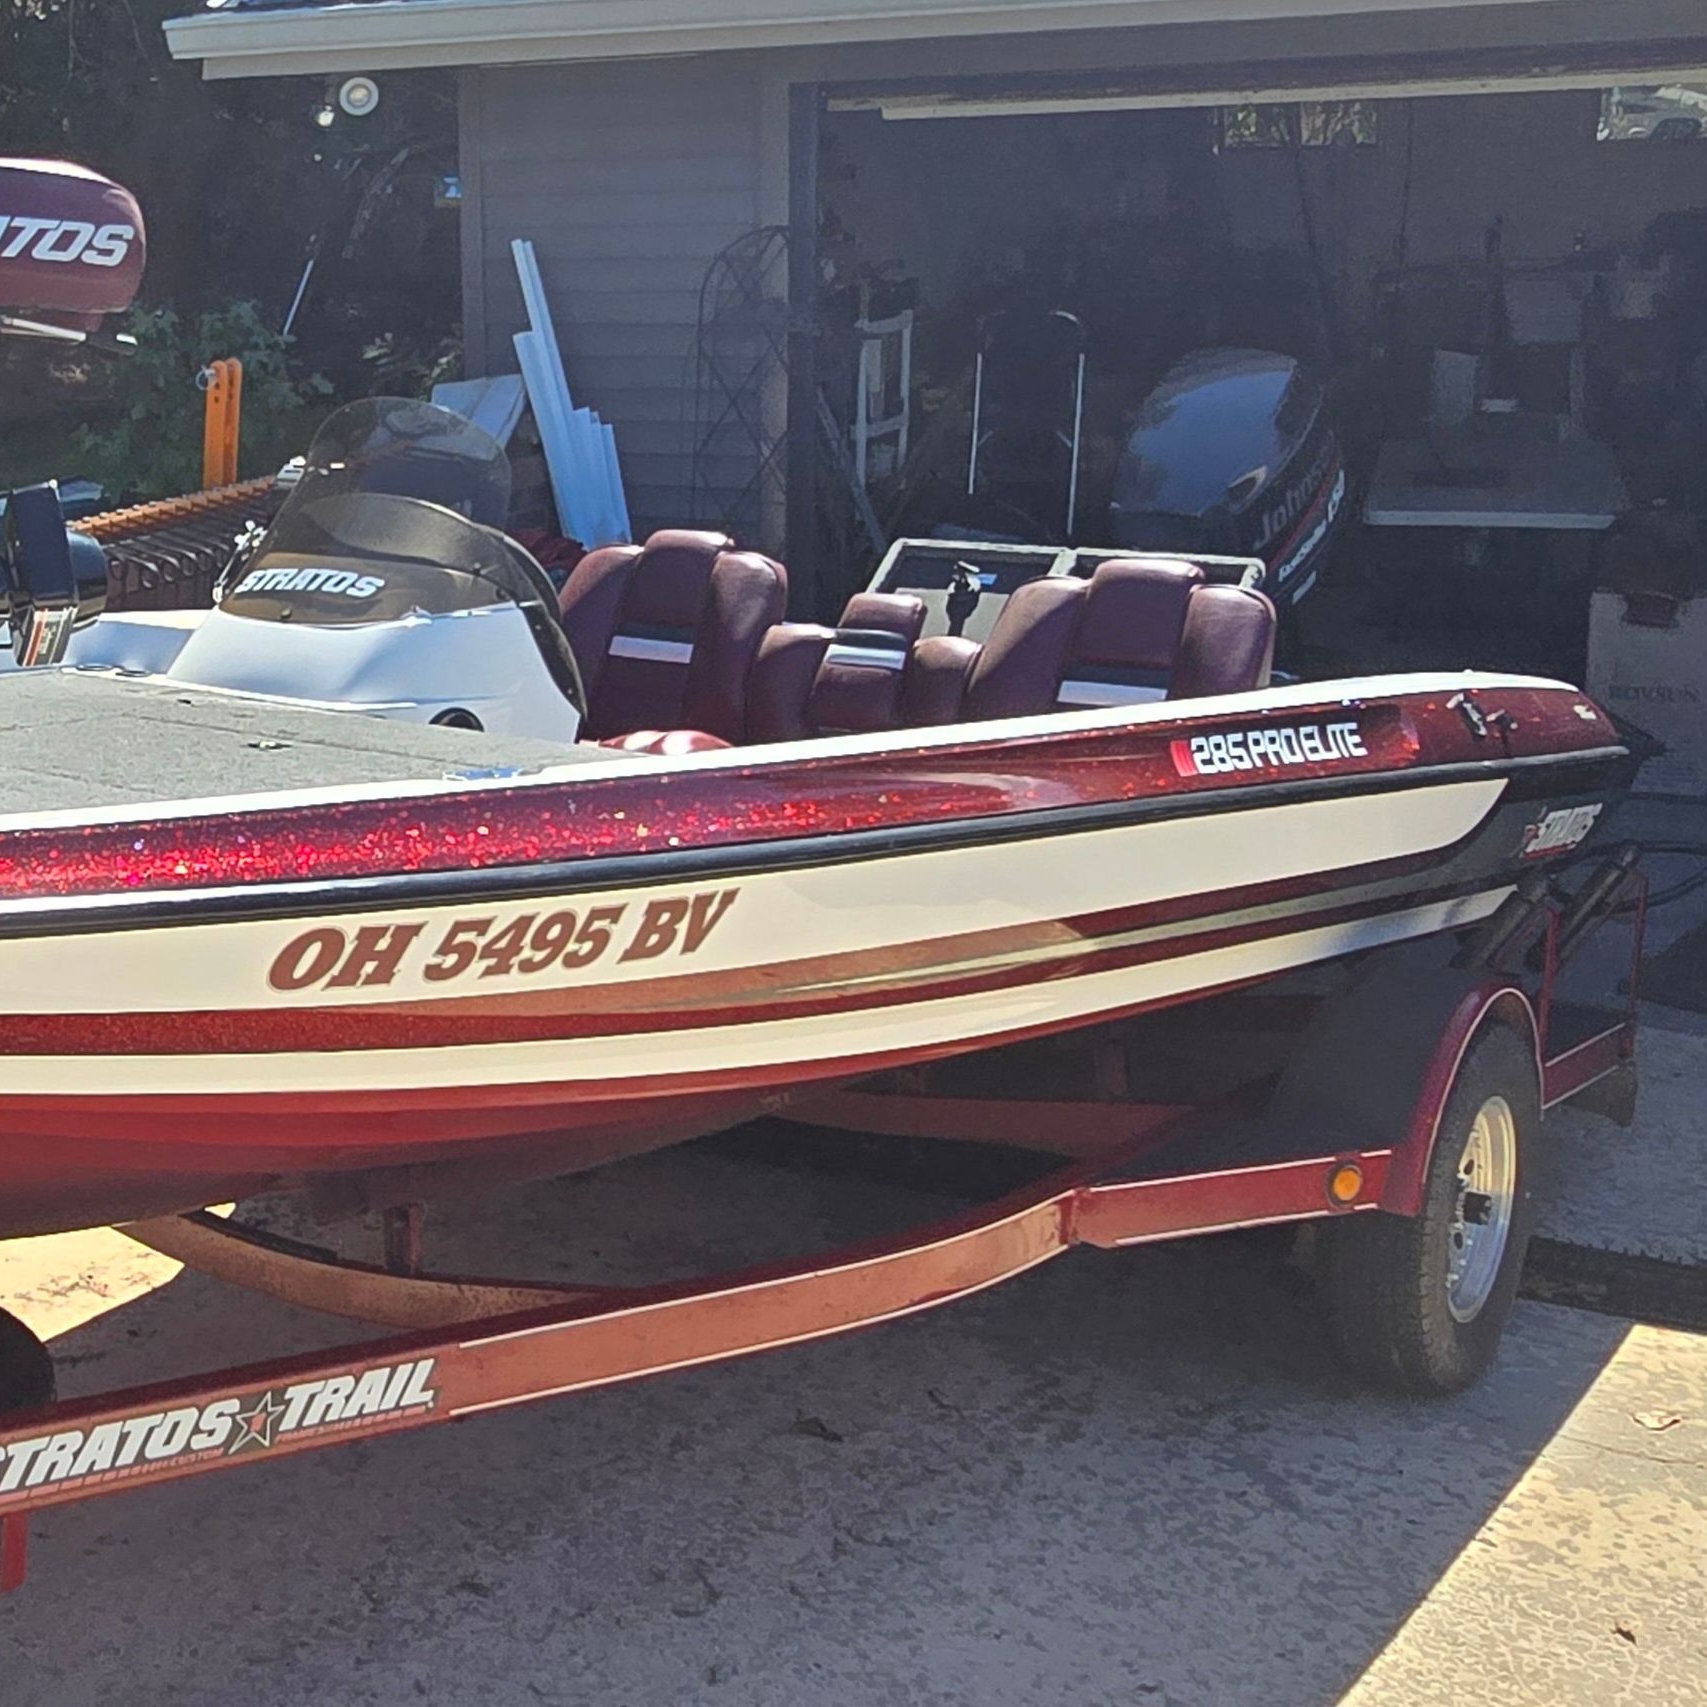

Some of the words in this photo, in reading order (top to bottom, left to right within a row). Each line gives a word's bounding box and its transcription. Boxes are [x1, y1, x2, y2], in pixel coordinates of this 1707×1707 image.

[233, 567, 386, 598] STRATOS
[1190, 732, 1253, 774] 285
[1247, 727, 1305, 768] PRO
[266, 921, 428, 991] OH
[422, 904, 626, 983] 5495
[615, 886, 741, 965] BV
[277, 1357, 437, 1433] TRAIL
